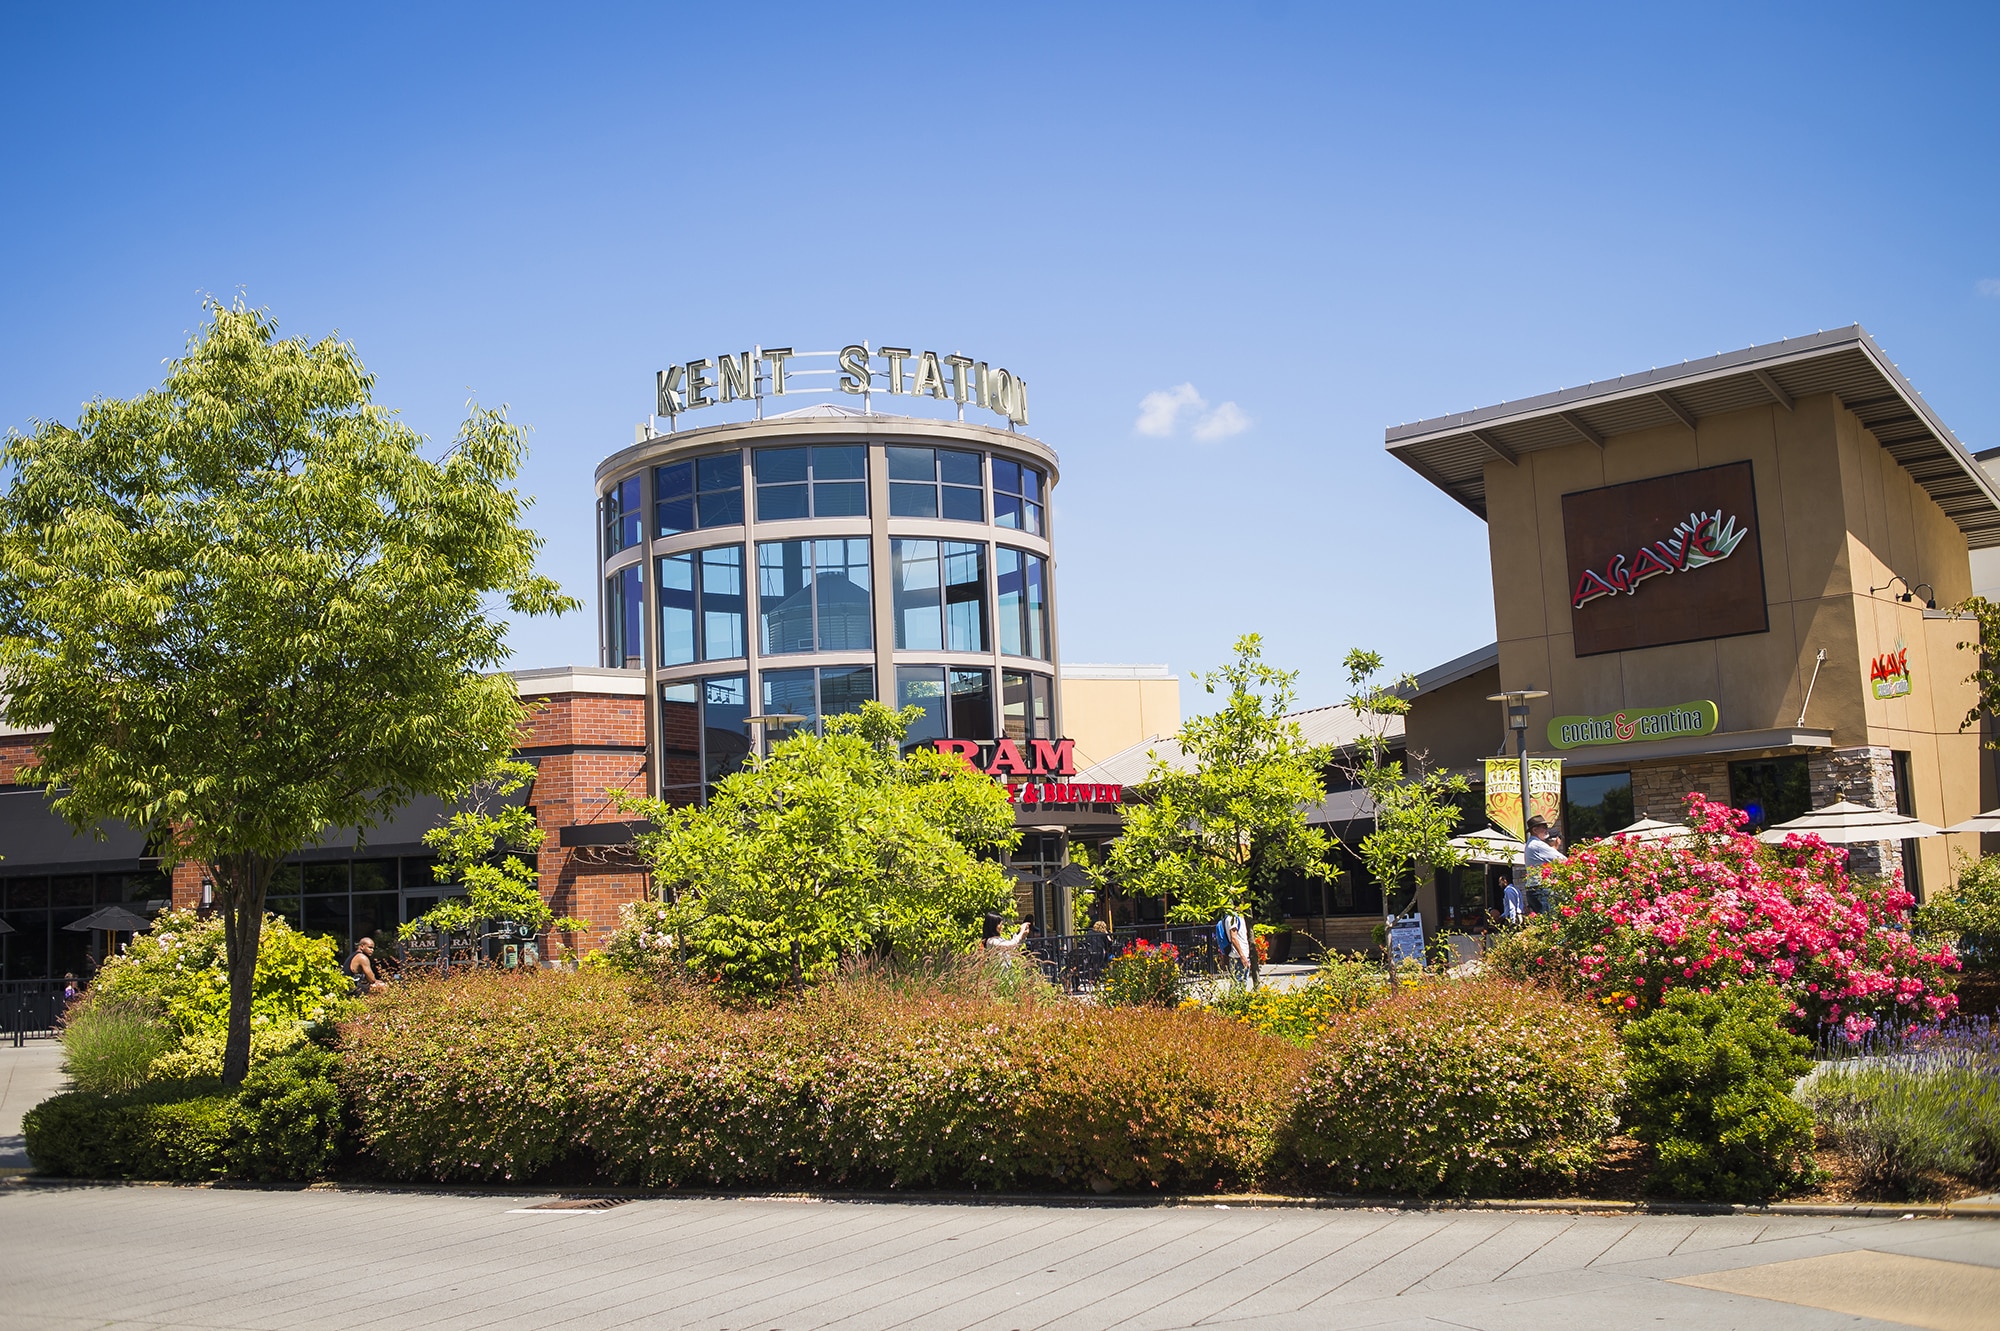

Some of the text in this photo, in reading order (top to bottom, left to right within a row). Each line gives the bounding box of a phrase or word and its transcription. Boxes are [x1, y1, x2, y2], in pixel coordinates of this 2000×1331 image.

[656, 348, 795, 417] KENT
[1573, 517, 1724, 609] AGAVE
[1871, 647, 1910, 683] AGAVE
[1561, 708, 1703, 744] cocina & cantina
[933, 738, 1078, 775] RAM
[1488, 769, 1520, 784] KENT
[1488, 783, 1520, 794] STATION
[1531, 769, 1560, 784] KENT
[1020, 782, 1040, 803] &
[1043, 783, 1123, 803] BREWERY
[410, 940, 436, 948] RAM
